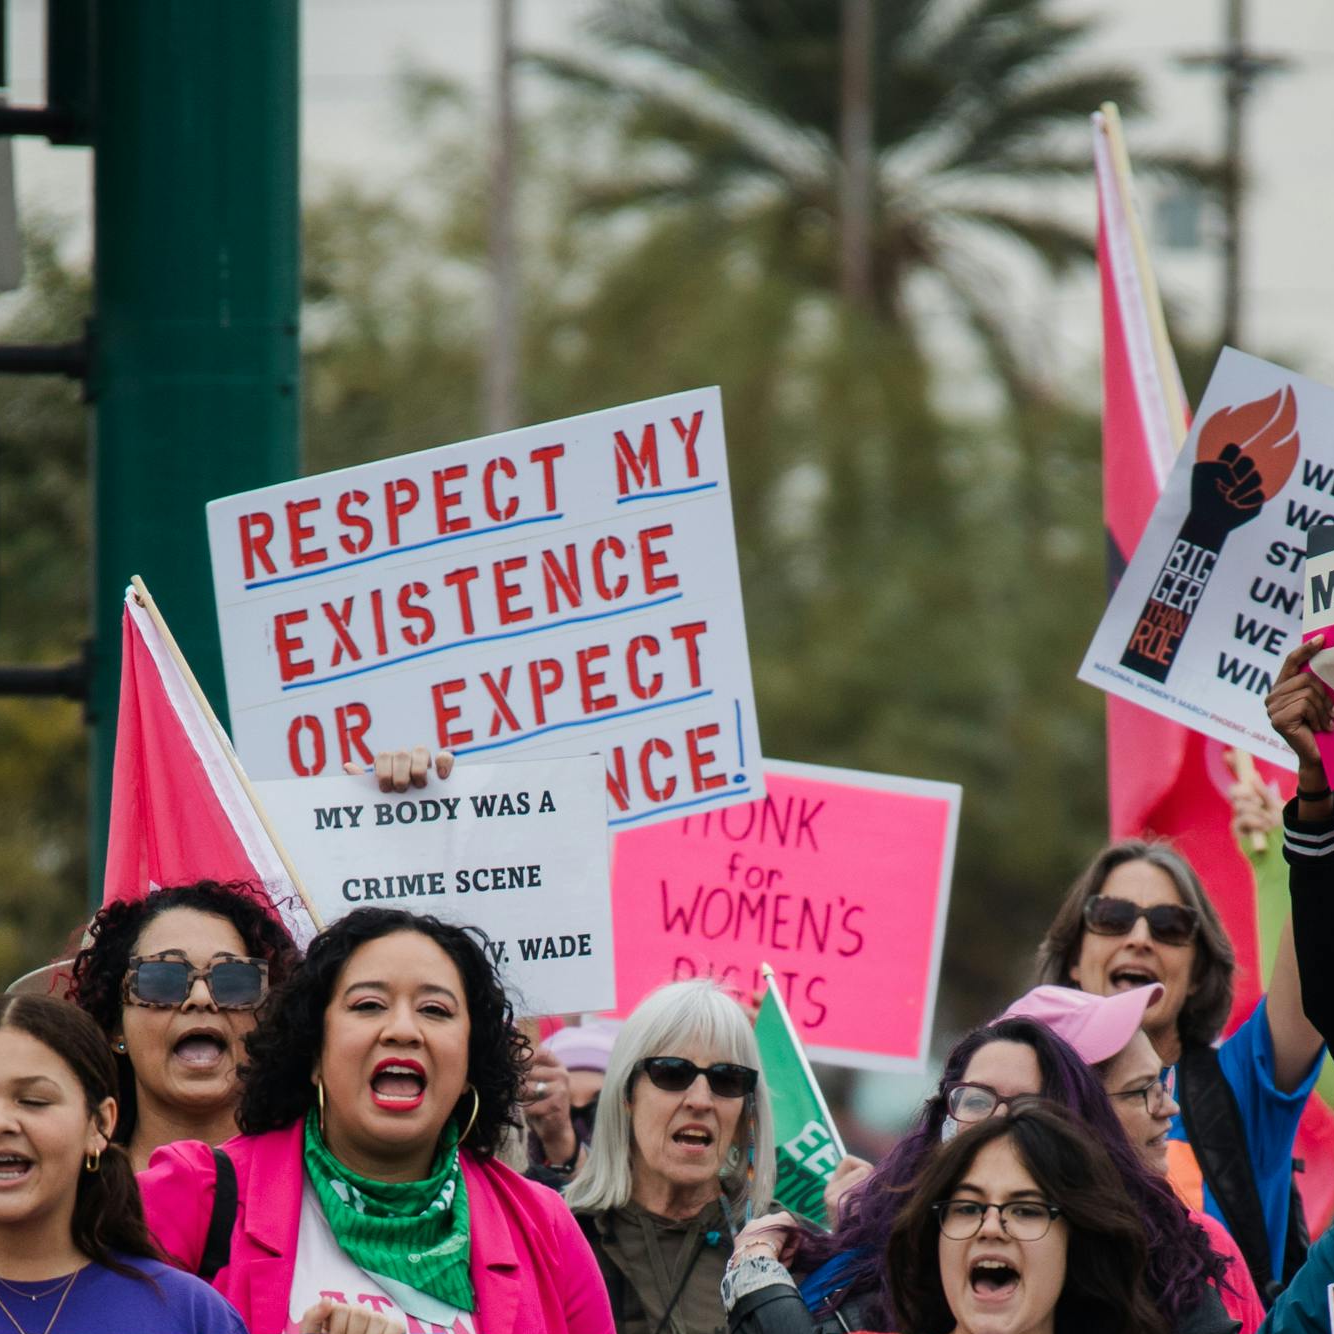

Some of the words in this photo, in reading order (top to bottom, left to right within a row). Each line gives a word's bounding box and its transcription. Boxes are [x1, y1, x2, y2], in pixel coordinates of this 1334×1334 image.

[239, 443, 566, 580] RESPECT
[613, 410, 706, 495] MY
[1165, 538, 1219, 583] BIG
[273, 523, 679, 682] EXISTENCE
[1151, 569, 1205, 615] GER
[1146, 600, 1188, 635] THAN
[1234, 612, 1288, 656] WE
[1129, 619, 1181, 667] ROE
[288, 700, 374, 777] OR
[431, 621, 709, 749] EXPECT
[314, 805, 364, 830] MY
[374, 797, 461, 826] BODY
[470, 791, 531, 819] WAS
[539, 790, 556, 813] A
[342, 872, 446, 902] CRIME
[456, 864, 542, 894] SCENE
[729, 852, 782, 890] for
[661, 881, 865, 958] WOMEN'S
[518, 934, 592, 961] WADE
